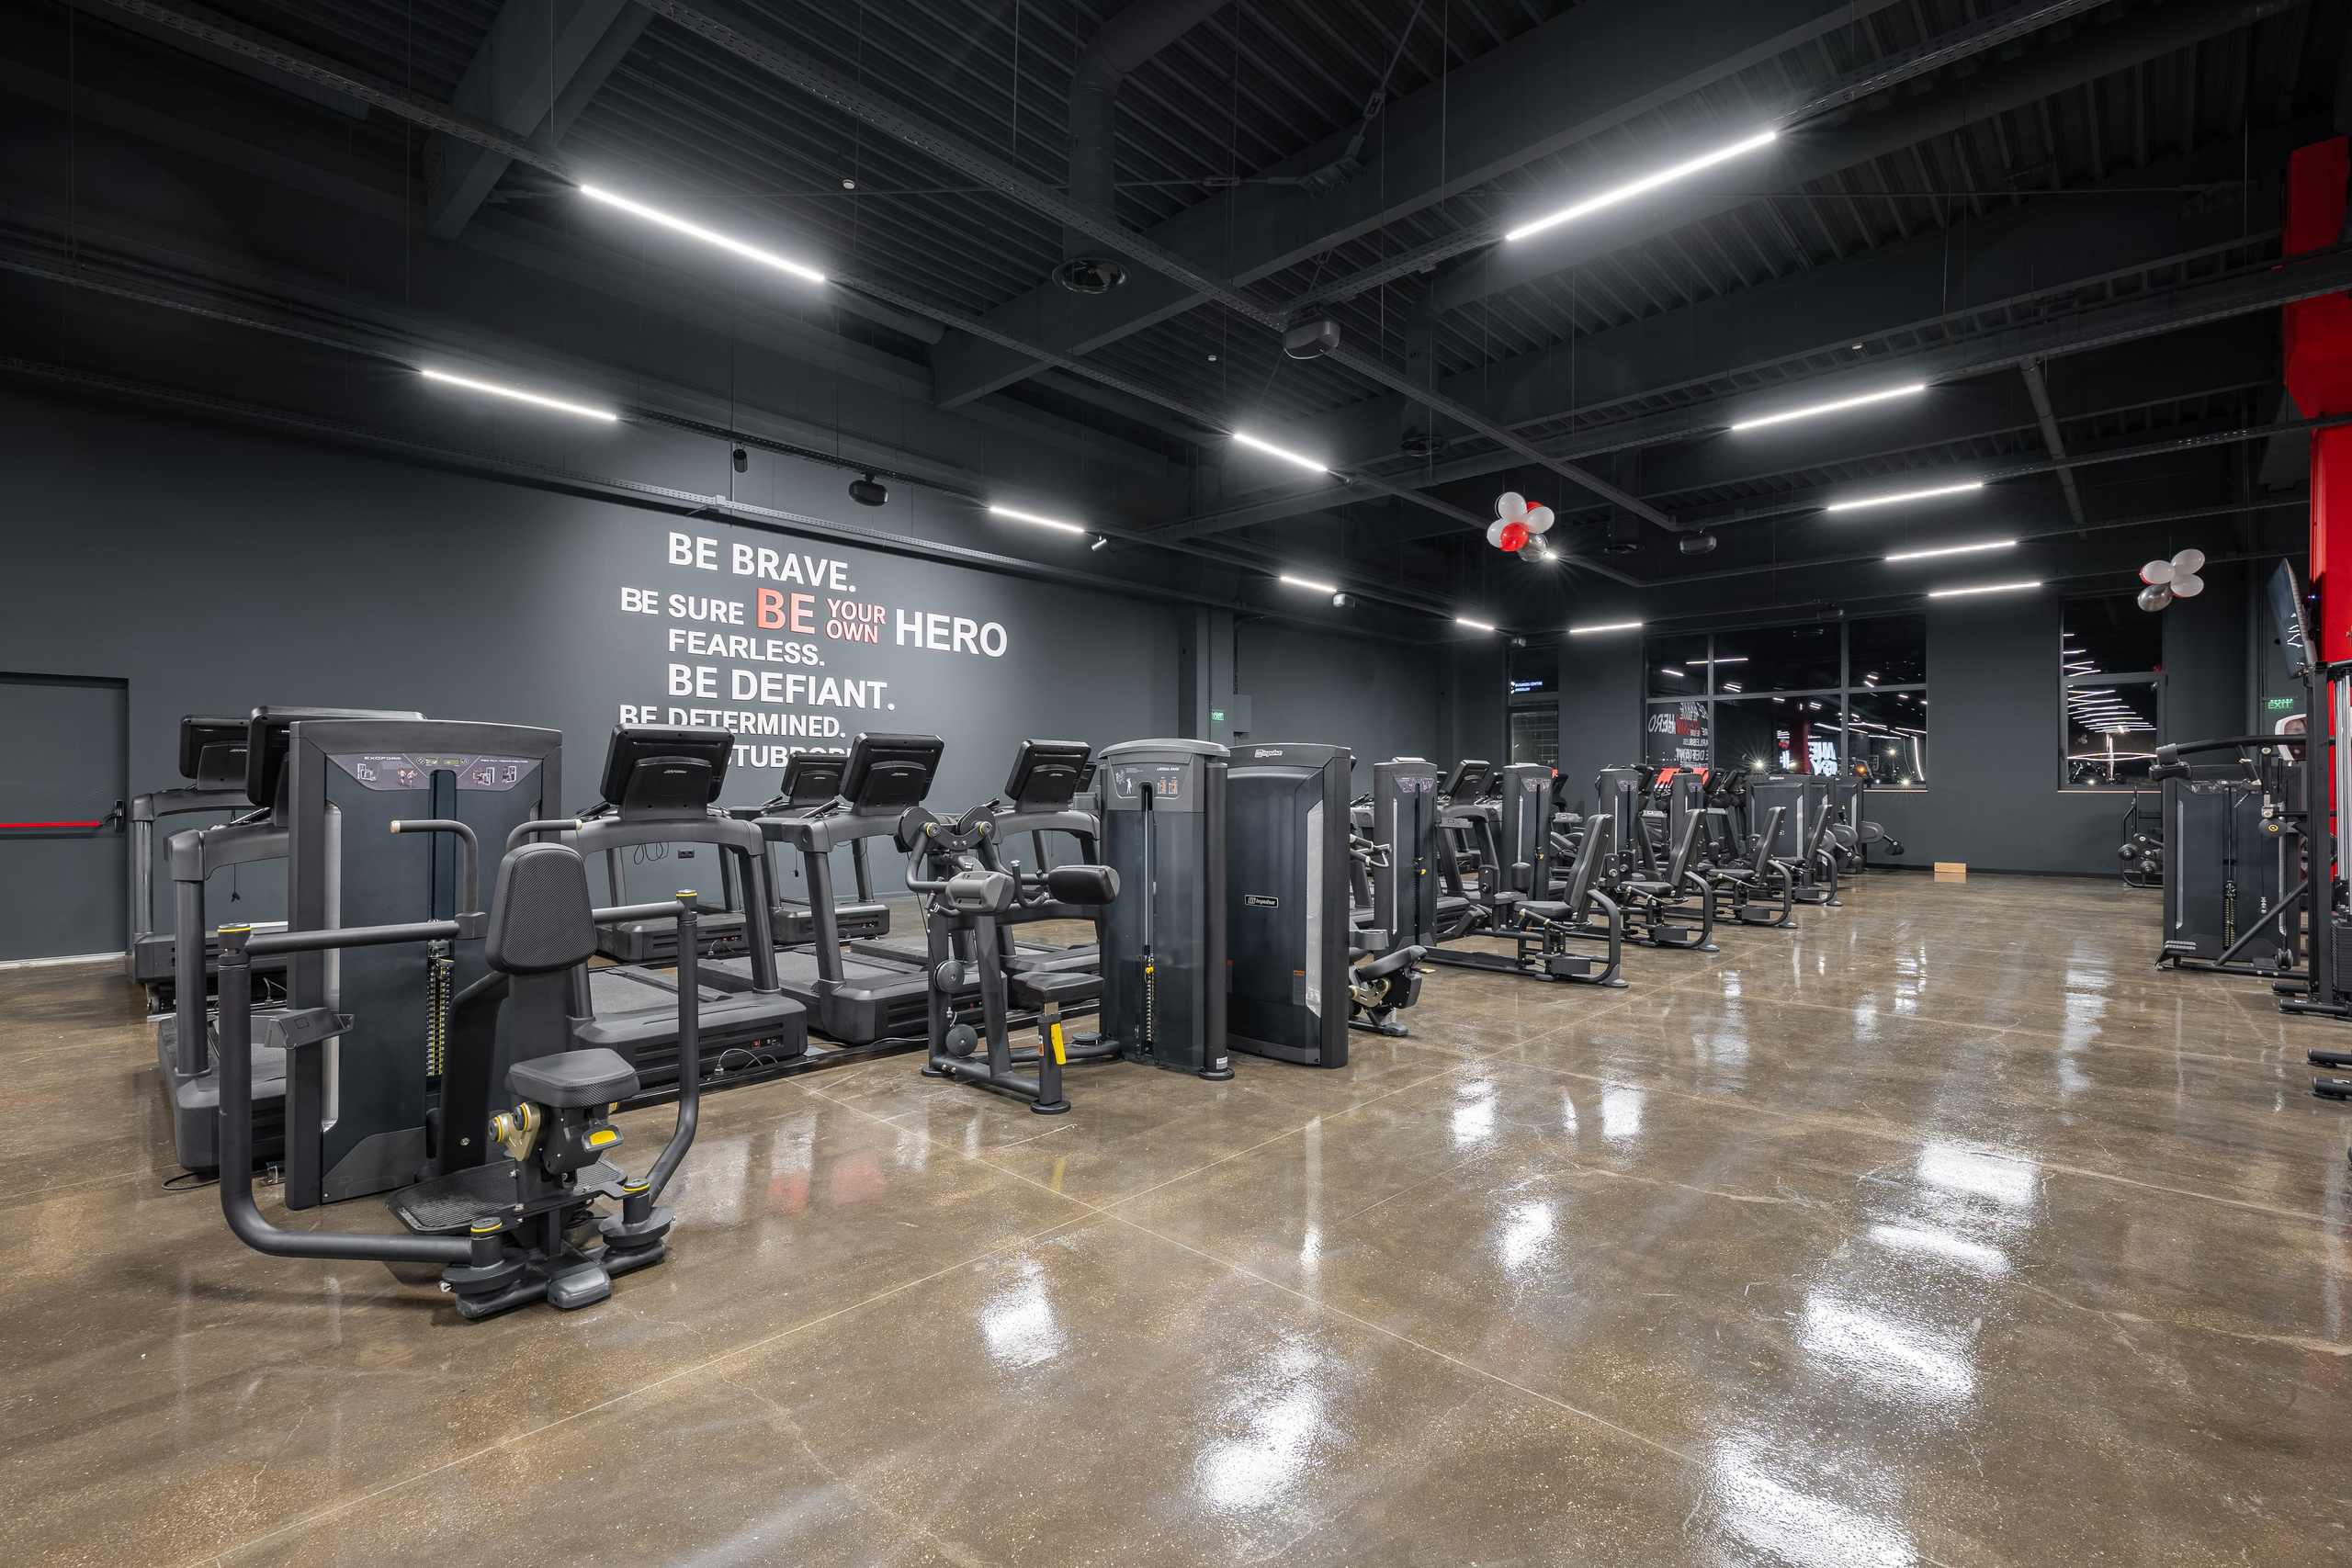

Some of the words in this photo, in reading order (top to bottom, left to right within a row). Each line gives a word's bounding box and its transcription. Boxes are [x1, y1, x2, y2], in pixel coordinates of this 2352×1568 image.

[669, 531, 718, 571] BE
[732, 543, 856, 592] BRAVE.
[620, 586, 659, 615] BE
[668, 594, 744, 626] SURE
[757, 588, 816, 635] BE
[827, 598, 887, 626] YOUR
[668, 628, 826, 667] FEARLESS.
[826, 620, 879, 645] OWN
[896, 609, 1008, 658] HERO
[668, 663, 718, 699] BE
[731, 669, 896, 712] DEFIANT.
[620, 704, 658, 724] BE
[668, 707, 846, 739] DETERMINED.
